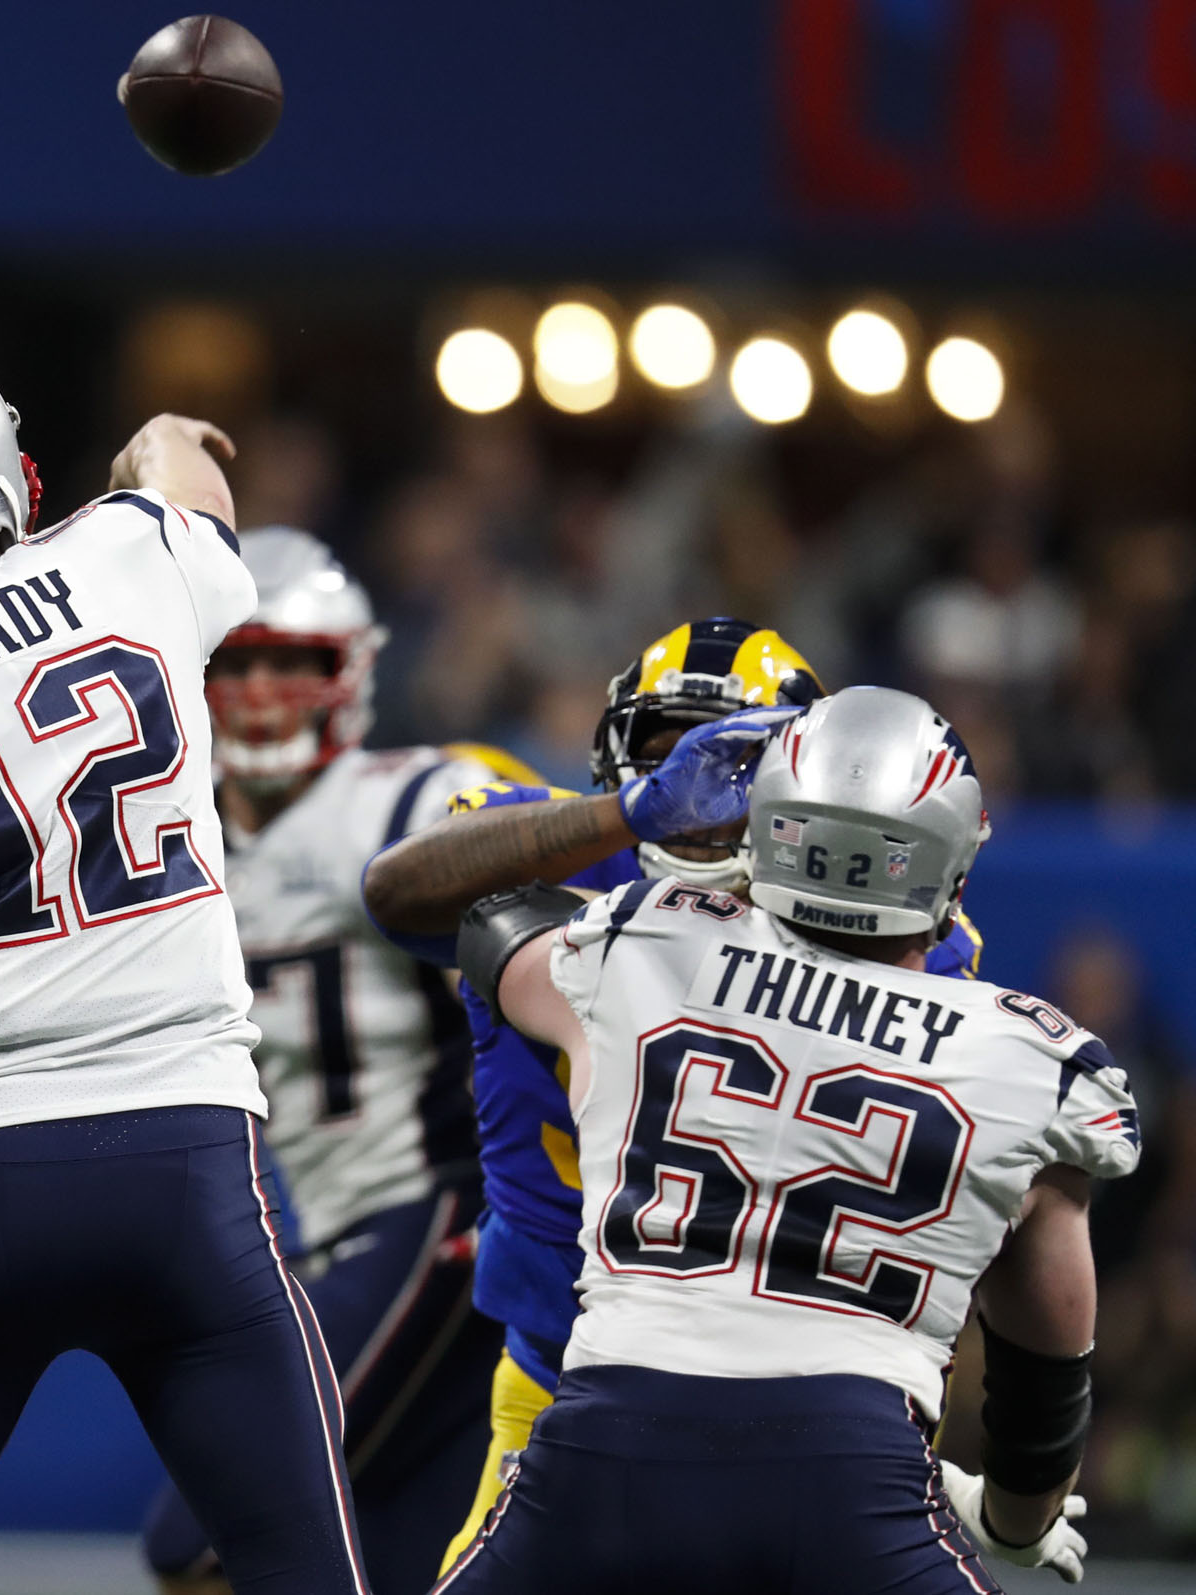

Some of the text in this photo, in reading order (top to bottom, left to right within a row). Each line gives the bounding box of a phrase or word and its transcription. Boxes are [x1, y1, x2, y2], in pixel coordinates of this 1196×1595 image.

[806, 845, 872, 888] 62
[792, 900, 879, 933] PATRIOTS
[712, 944, 966, 1064] THUNEY
[994, 990, 1087, 1044] 6
[597, 1017, 976, 1329] 62
